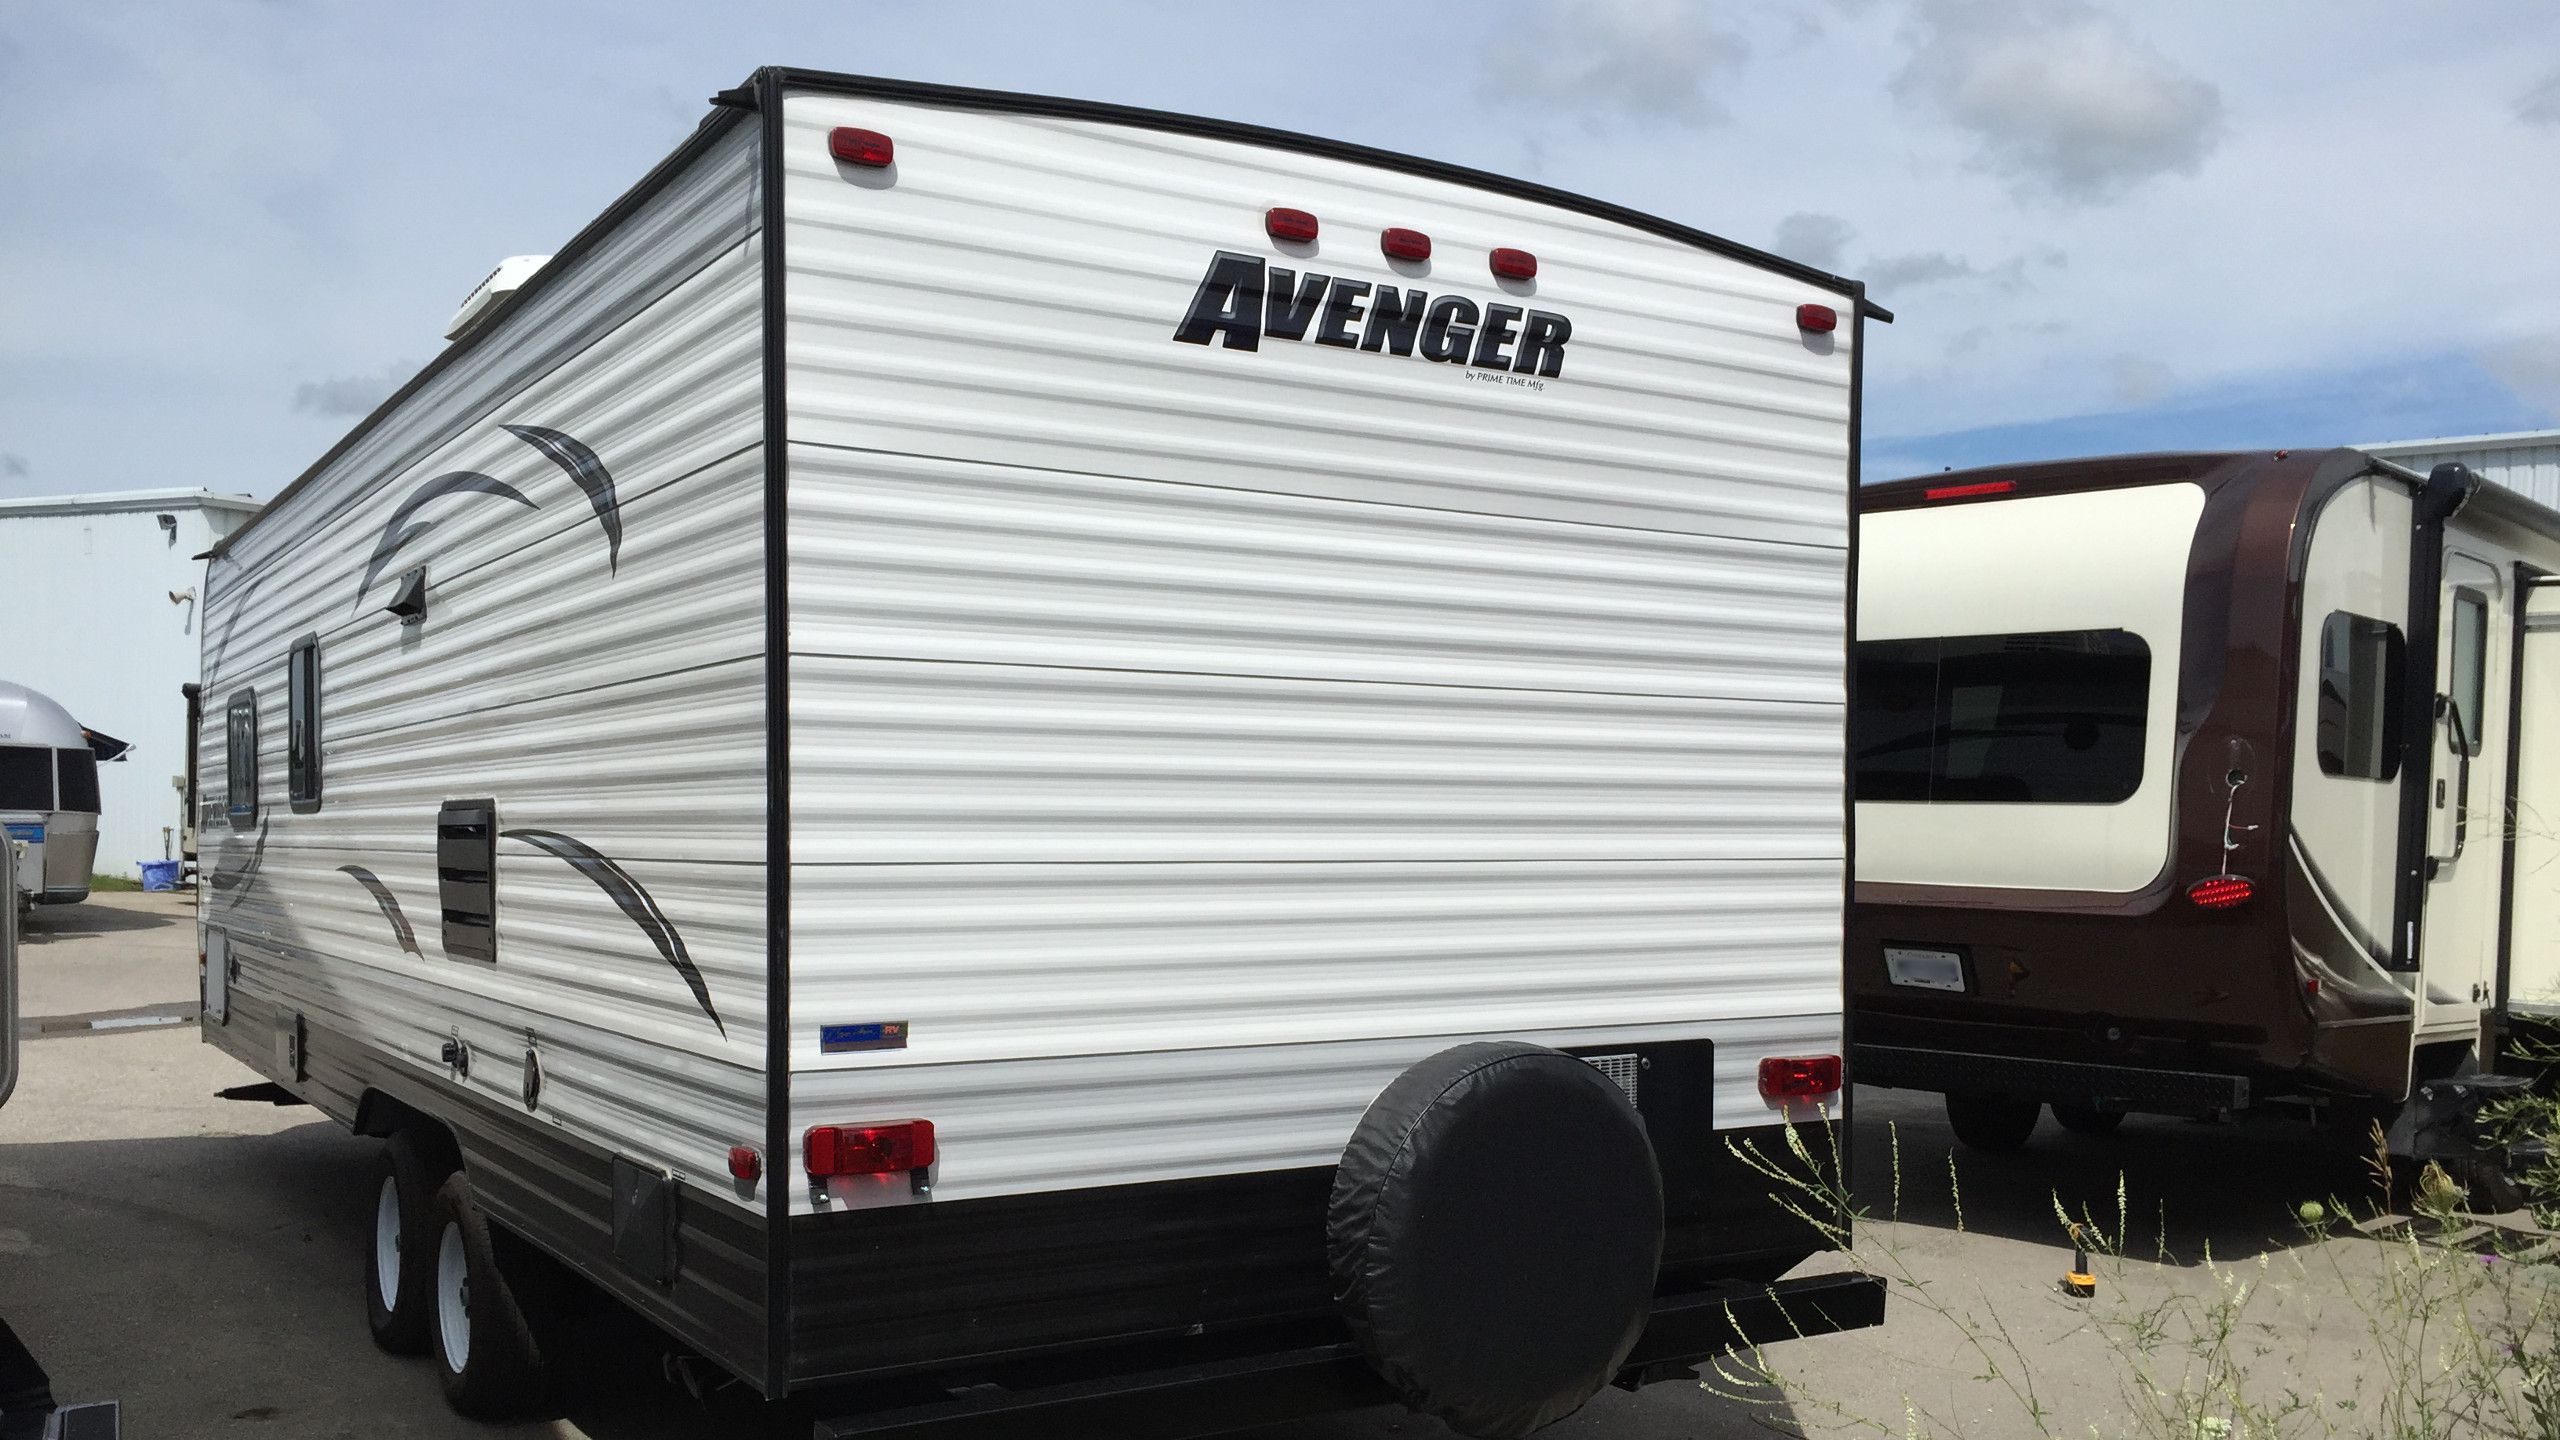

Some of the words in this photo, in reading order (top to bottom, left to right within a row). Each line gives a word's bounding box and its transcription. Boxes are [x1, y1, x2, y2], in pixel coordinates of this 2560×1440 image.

[1173, 250, 1573, 379] AVENGER
[1465, 370, 1475, 382] by
[1477, 372, 1504, 384] PRIME
[1506, 376, 1526, 387] TIME
[884, 1025, 900, 1034] RV
